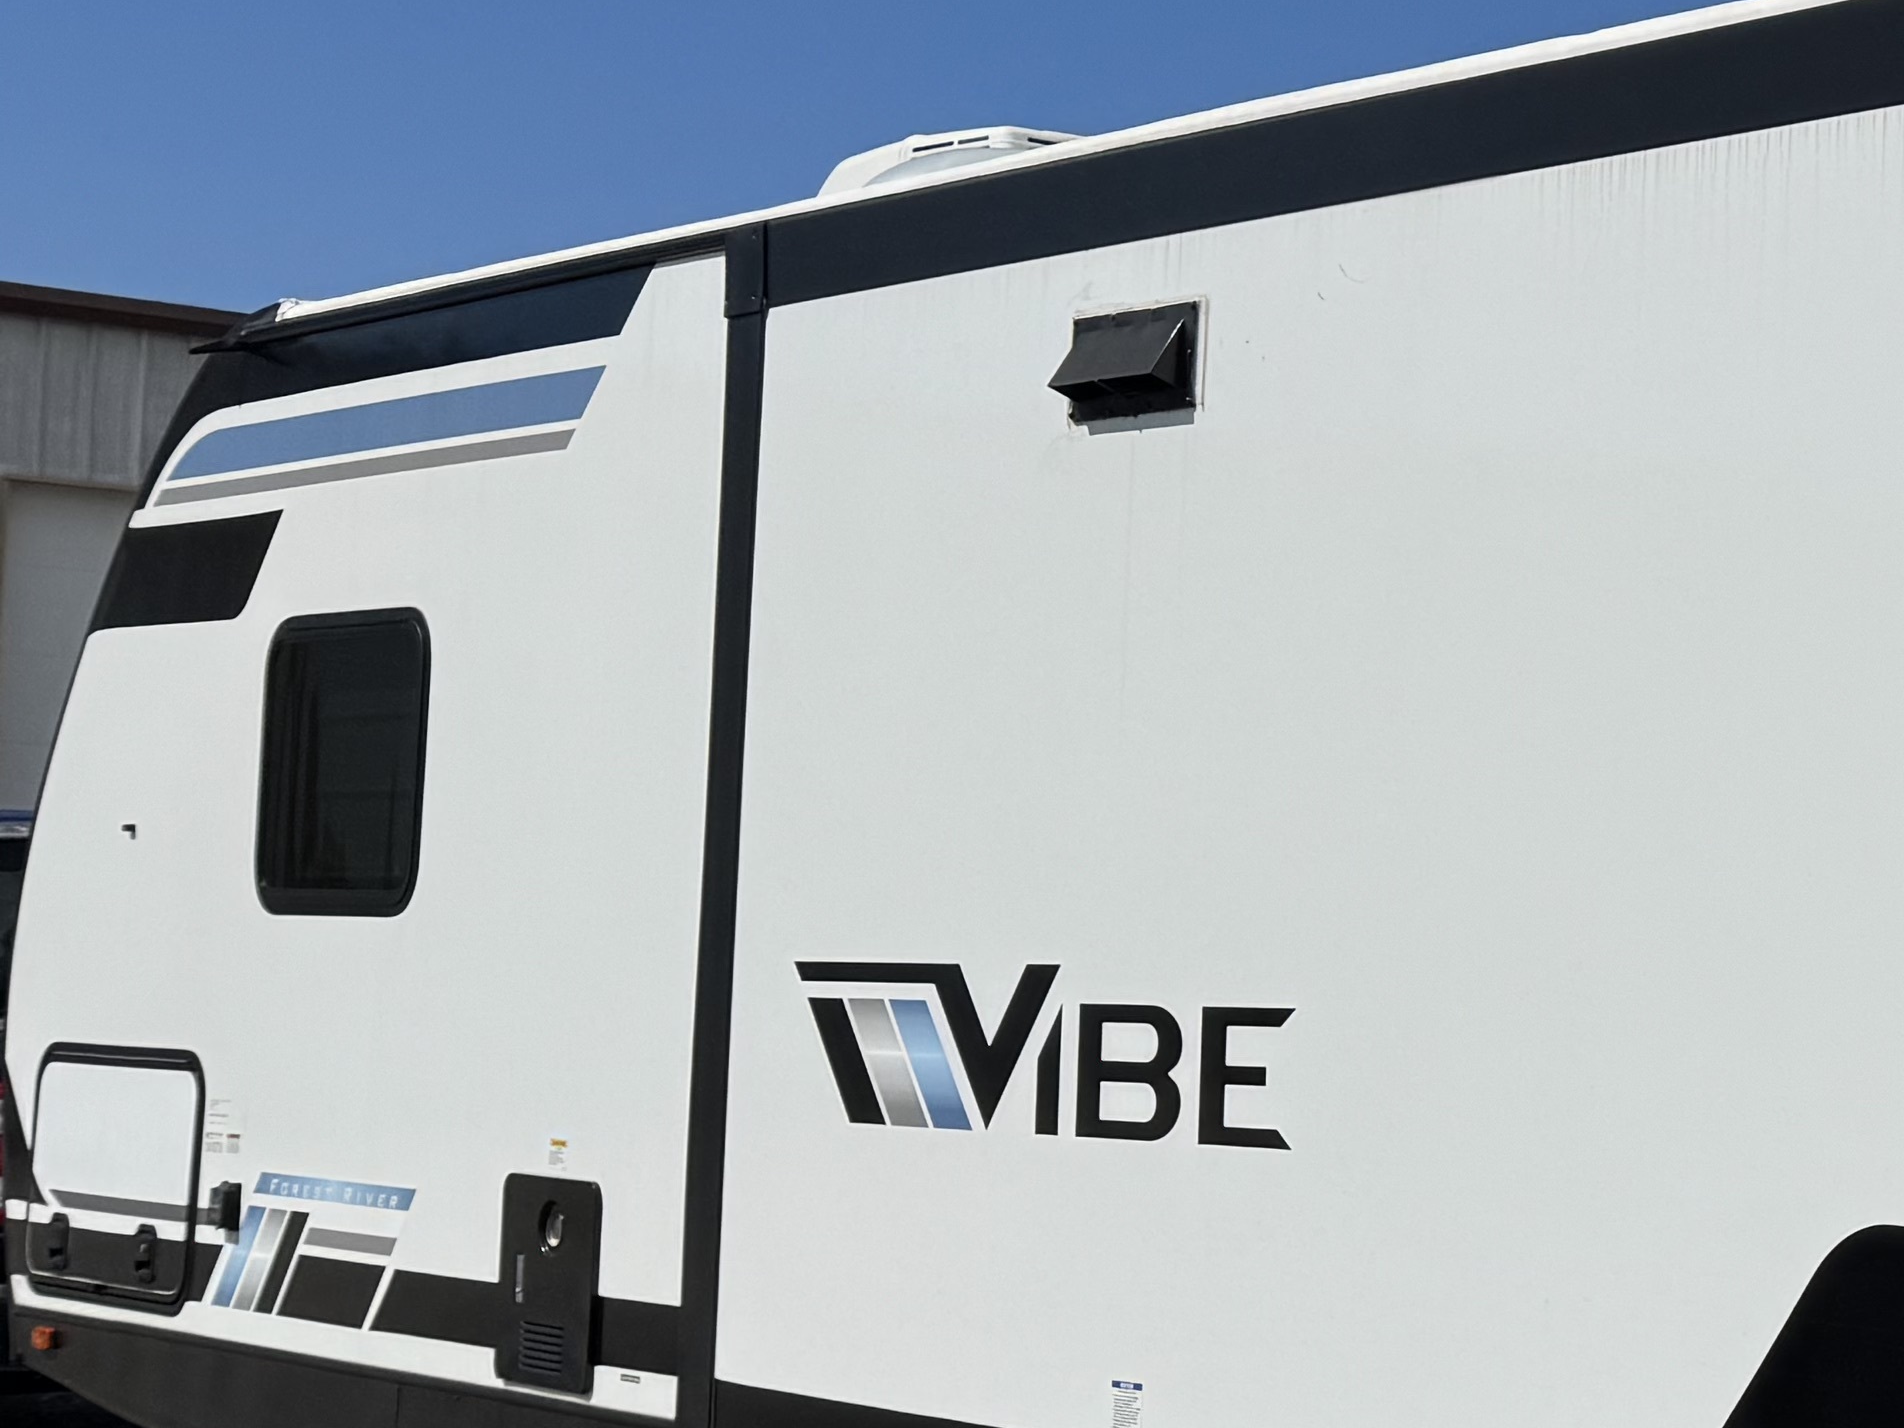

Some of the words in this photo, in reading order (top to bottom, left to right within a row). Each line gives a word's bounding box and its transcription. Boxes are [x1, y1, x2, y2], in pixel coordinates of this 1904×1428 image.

[794, 960, 1297, 1151] VIBE
[269, 1178, 334, 1200] FOREST
[342, 1187, 399, 1209] RIVER
